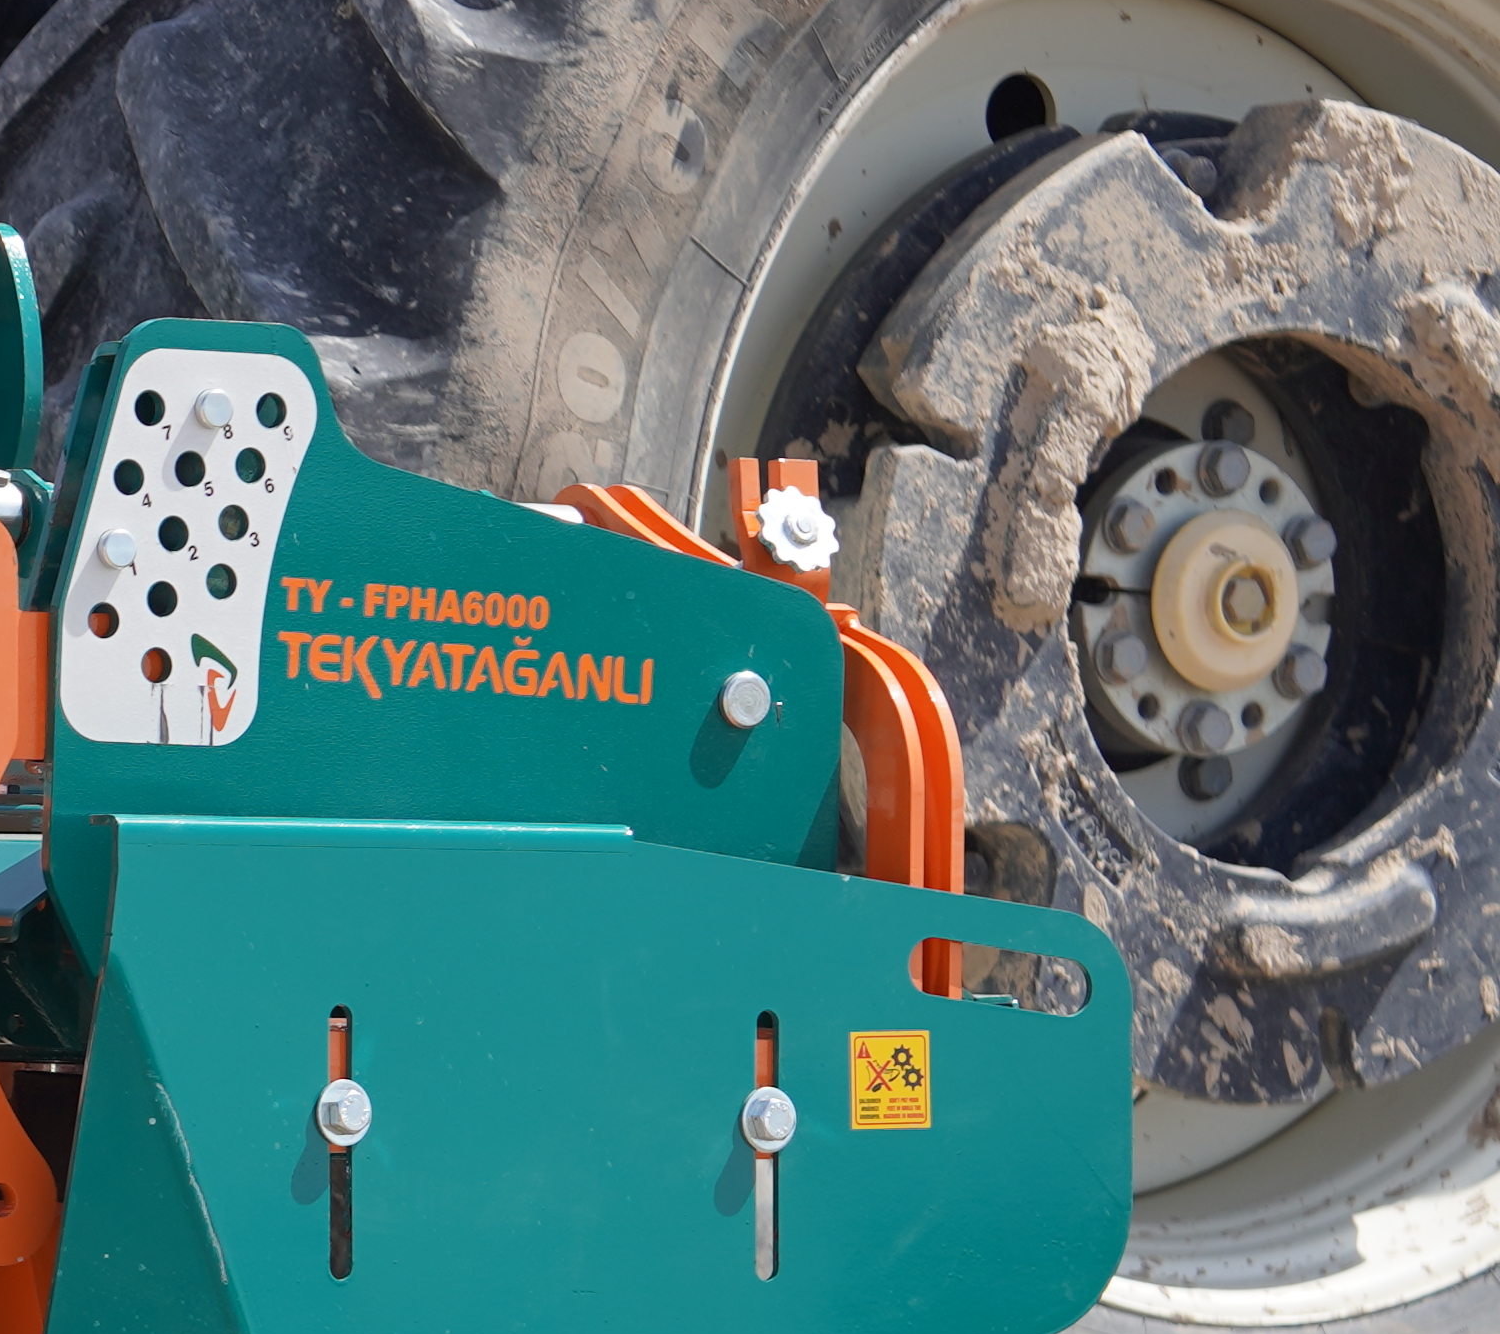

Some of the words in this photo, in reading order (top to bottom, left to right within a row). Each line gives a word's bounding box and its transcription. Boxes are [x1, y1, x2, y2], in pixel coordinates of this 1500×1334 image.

[162, 424, 173, 441] 7
[222, 424, 234, 440] 8
[141, 493, 152, 509] 4
[203, 481, 215, 497] 5
[264, 478, 275, 494] 6
[187, 545, 198, 562] 2
[249, 531, 260, 548] 3
[280, 576, 333, 614] TY
[363, 583, 550, 630] FPHA6000
[277, 630, 655, 705] TEKYATAĞANLI
